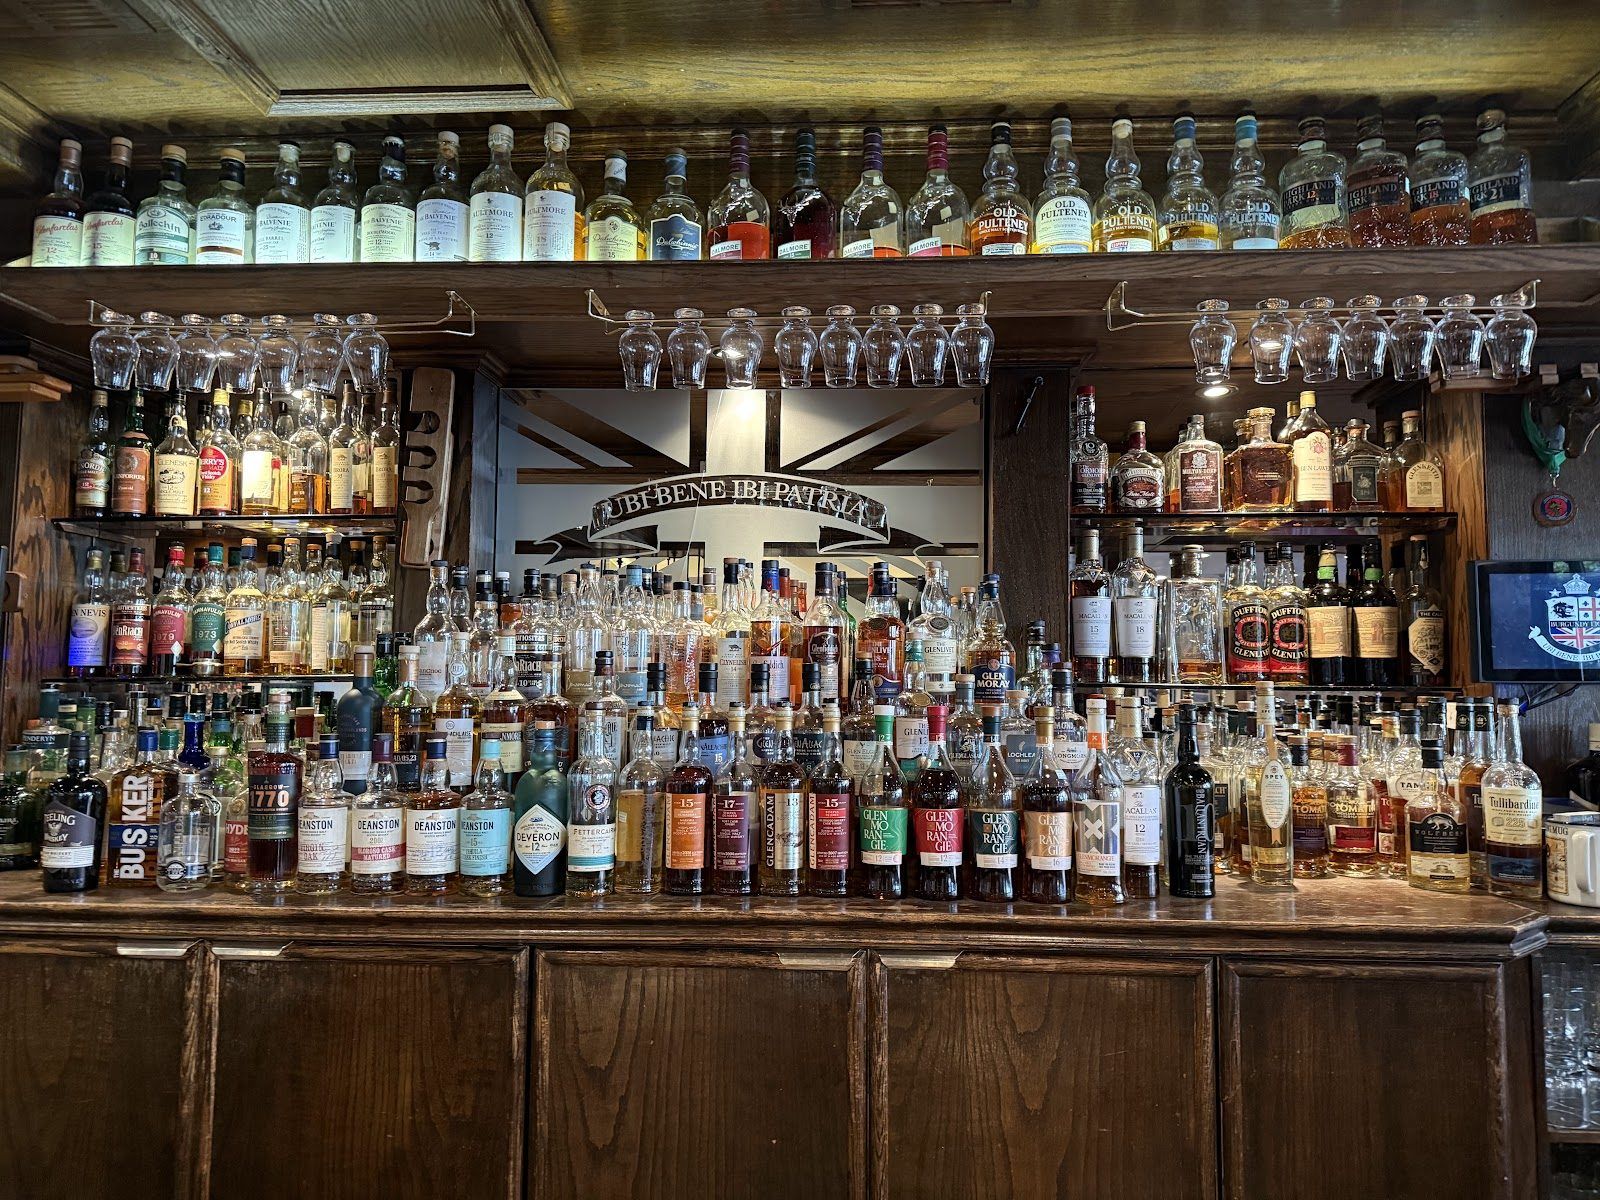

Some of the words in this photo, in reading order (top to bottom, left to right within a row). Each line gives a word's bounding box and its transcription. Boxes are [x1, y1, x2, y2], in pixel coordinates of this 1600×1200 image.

[1349, 182, 1397, 200] IGHLAND
[1489, 188, 1504, 200] 21
[1055, 200, 1076, 209] OLD
[1188, 202, 1209, 213] OLD
[1246, 202, 1271, 213] OLD
[993, 208, 1018, 218] OLD
[1041, 209, 1088, 220] PULTENEY
[1118, 205, 1142, 215] OLD
[424, 213, 455, 222] BALVENIE
[1103, 215, 1154, 229] PULTENEY
[979, 218, 1029, 230] PULTENEY
[656, 236, 698, 249] Dalwhinnie
[711, 243, 741, 256] DALMORE
[779, 243, 808, 256] DALMORE
[201, 458, 224, 466] ERRY'S
[605, 491, 645, 520] UBI
[656, 480, 728, 507] BENE
[731, 479, 765, 500] IBI
[773, 480, 866, 518] PATRIA
[80, 608, 107, 617] NEVIS
[194, 630, 217, 639] 1973
[924, 646, 955, 654] GLENLIVET
[1542, 642, 1556, 655] UBI
[1556, 649, 1579, 661] BENE
[982, 671, 1006, 681] GLEN
[976, 680, 1010, 689] MORAY
[23, 734, 56, 743] ENDERYN
[714, 753, 723, 763] 15
[250, 790, 290, 807] 1770
[680, 798, 694, 807] 15
[722, 799, 735, 808] 17
[825, 798, 838, 807] 15
[1489, 796, 1540, 811] Tullibardine
[863, 810, 888, 821] GLEN
[926, 810, 953, 821] GLEN
[1126, 807, 1158, 815] ACALLAN
[982, 813, 1009, 824] GLEN
[1038, 814, 1065, 826] GLEN
[1505, 817, 1526, 829] 225
[120, 775, 148, 879] BUSKER
[299, 819, 333, 831] EANSTON
[357, 820, 400, 830] DEANSTON
[414, 820, 456, 831] DEANSTON
[766, 793, 776, 867] GLENCADAM
[870, 821, 889, 830] MO
[934, 821, 953, 831] MO
[992, 824, 1010, 834] MO
[1133, 823, 1146, 833] 12
[516, 831, 560, 842] DEVERON
[573, 828, 616, 836] FETTERCAIR
[864, 830, 882, 840] RAN
[926, 831, 948, 841] RAN
[1552, 827, 1569, 836] MUG
[470, 838, 478, 846] 15
[983, 833, 1005, 844] RAN
[1039, 834, 1061, 845] RAN
[531, 842, 540, 851] 12
[591, 844, 602, 854] 12
[870, 840, 886, 850] GIE
[935, 840, 951, 851] GIE
[991, 843, 1008, 854] GIE
[1047, 845, 1064, 855] GIE
[303, 852, 319, 862] OAK
[875, 854, 882, 862] 12
[939, 854, 948, 862] 12
